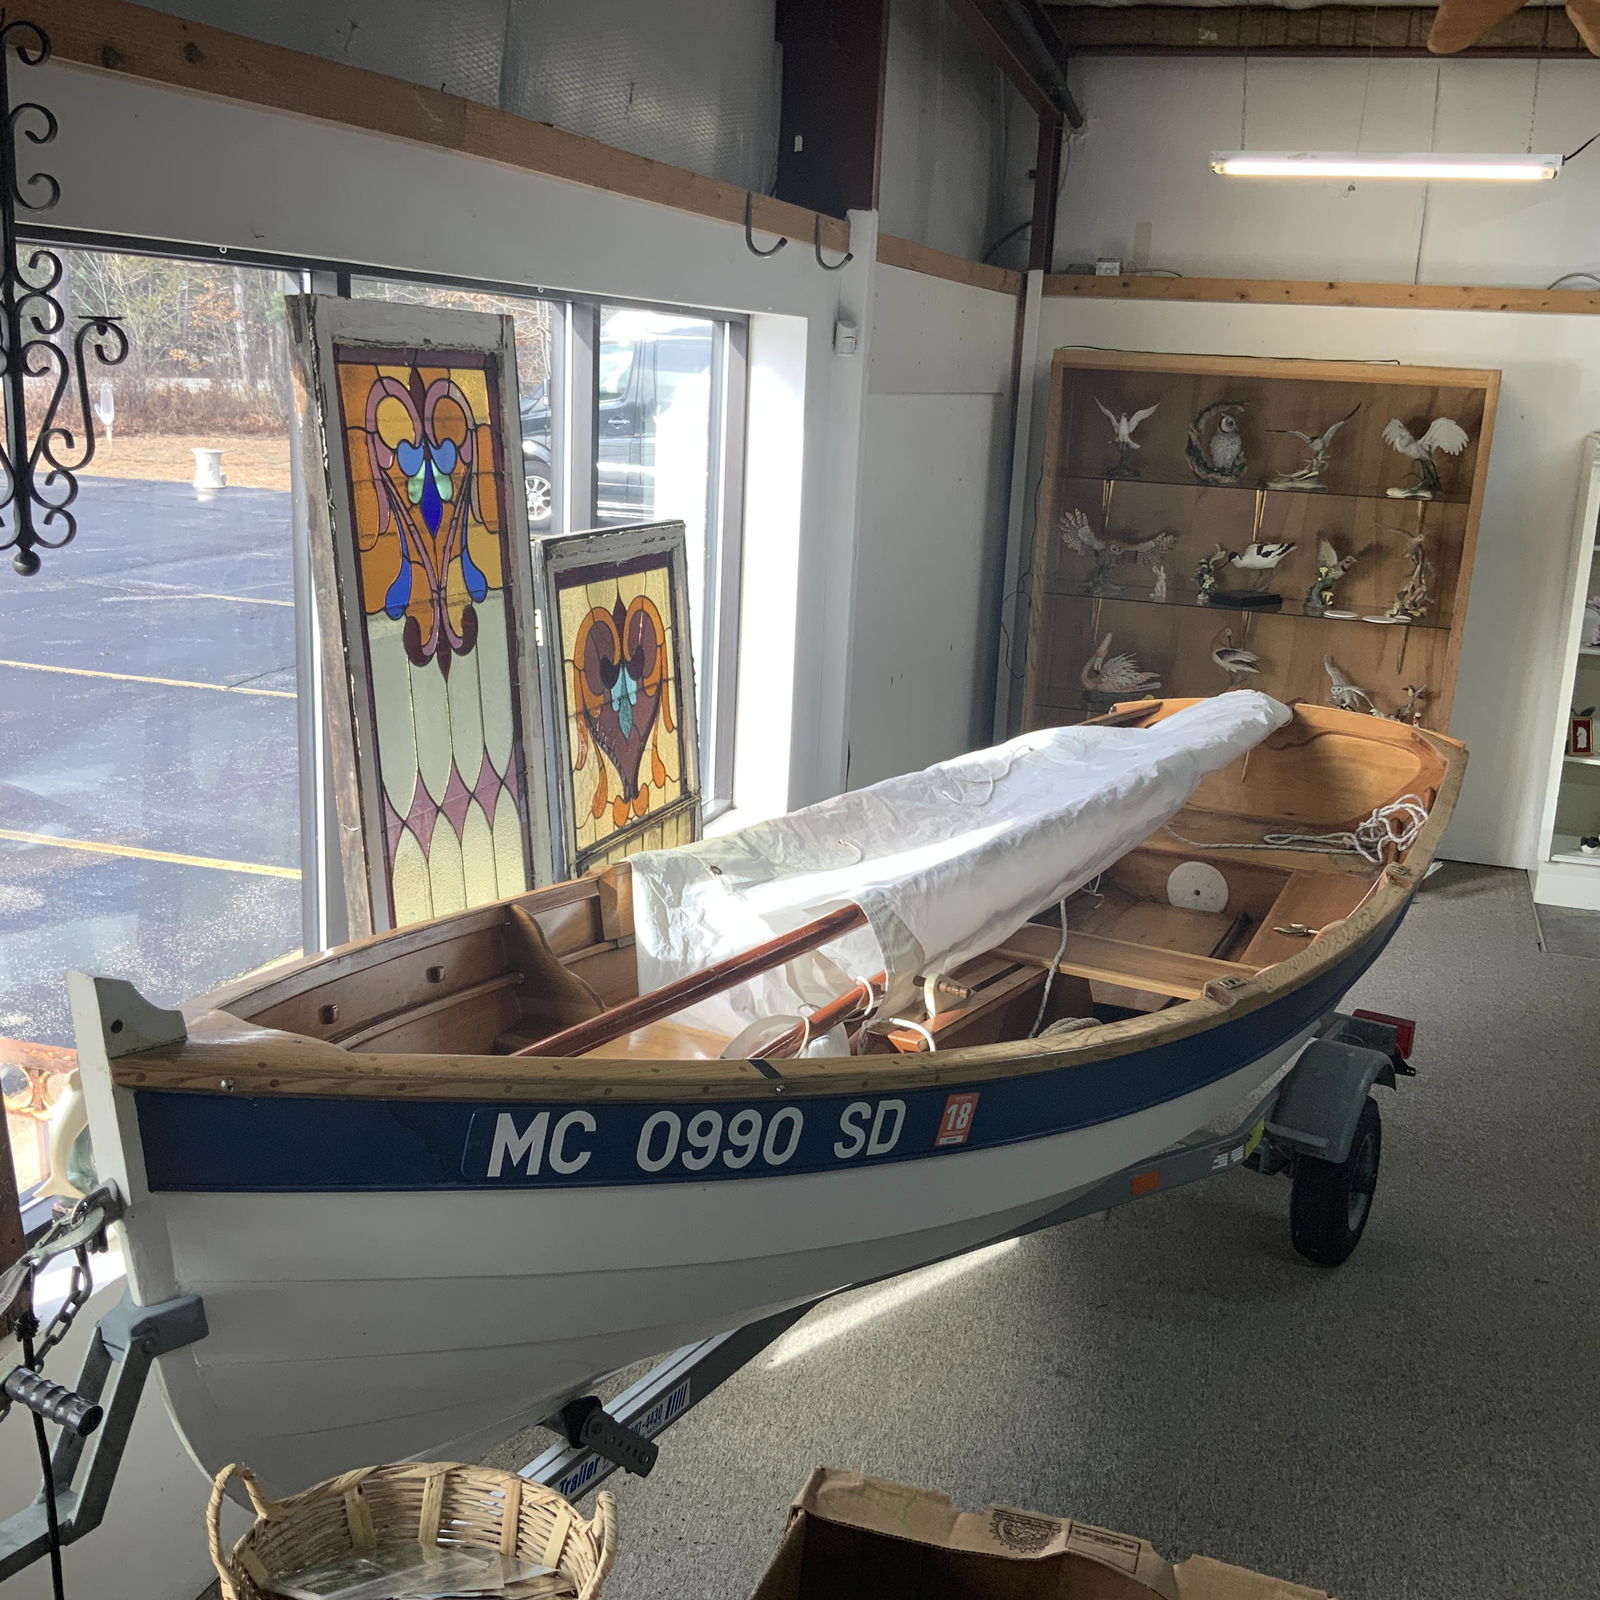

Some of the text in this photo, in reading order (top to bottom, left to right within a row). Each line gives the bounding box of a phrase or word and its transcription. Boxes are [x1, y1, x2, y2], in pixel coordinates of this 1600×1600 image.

[946, 1102, 972, 1130] 18
[487, 1099, 906, 1178] MC 0990 SD
[559, 1455, 602, 1496] Trailer
